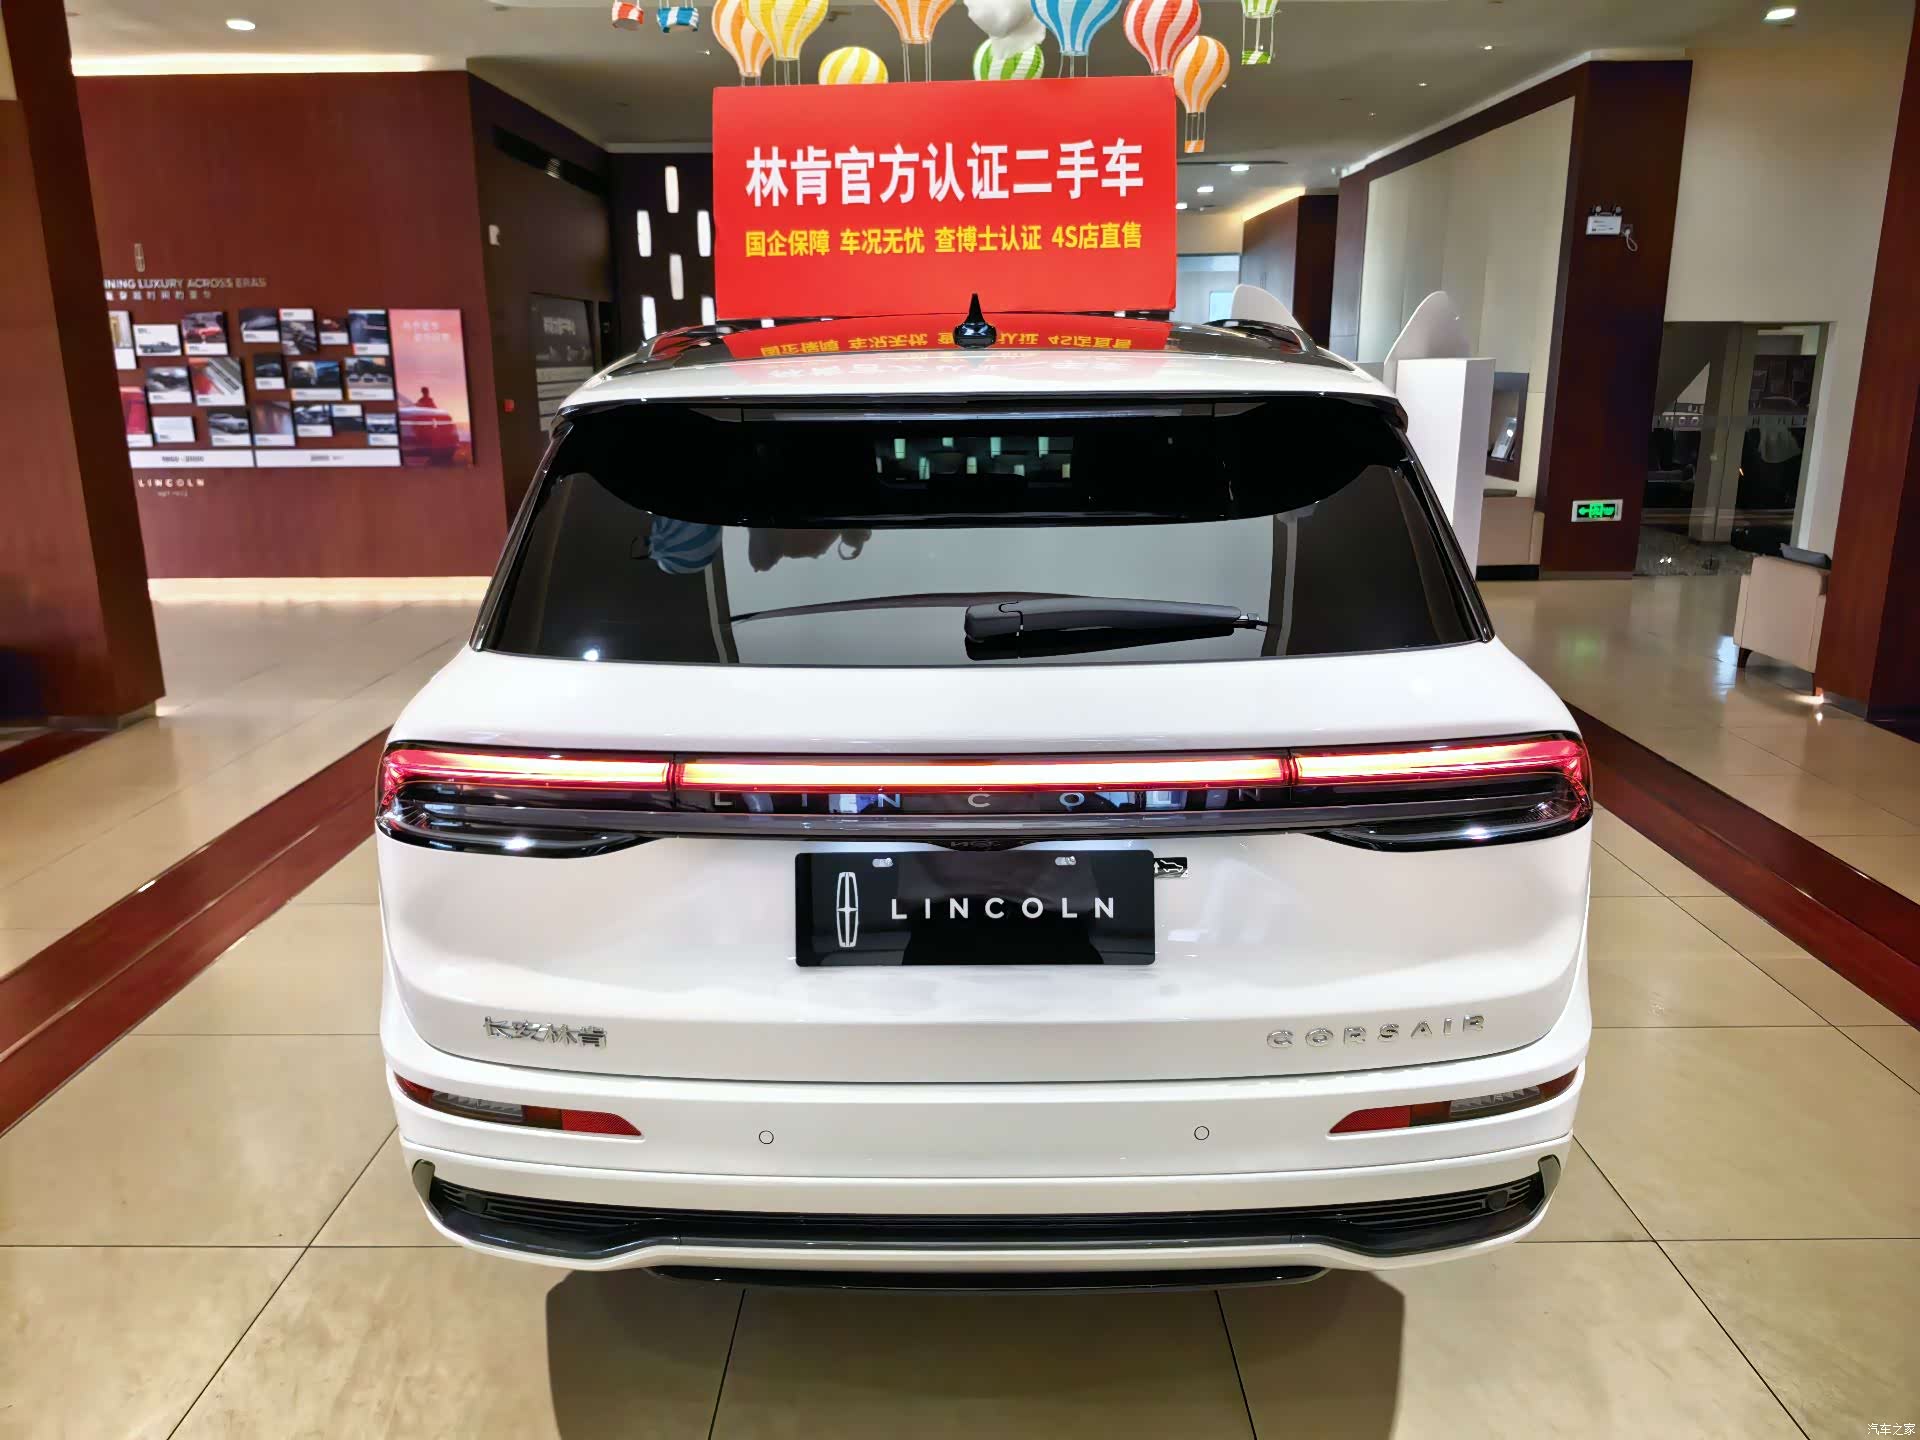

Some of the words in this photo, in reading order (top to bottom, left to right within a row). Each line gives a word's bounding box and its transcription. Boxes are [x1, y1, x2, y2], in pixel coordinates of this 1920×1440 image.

[745, 137, 1144, 207] 林肯官方认证二手车
[745, 229, 830, 257] 国企保障
[840, 227, 925, 255] 车况无忧
[935, 224, 1041, 252] 查博士认证
[1052, 221, 1142, 249] 4S店直售
[138, 279, 184, 289] LUXURY
[187, 278, 233, 289] ACROSS
[235, 277, 268, 288] ERAS
[137, 478, 205, 488] LINCOLN
[891, 897, 1114, 919] LINCOLN
[483, 1015, 607, 1048] 长安林肯
[1266, 1015, 1485, 1049] CORSAIR
